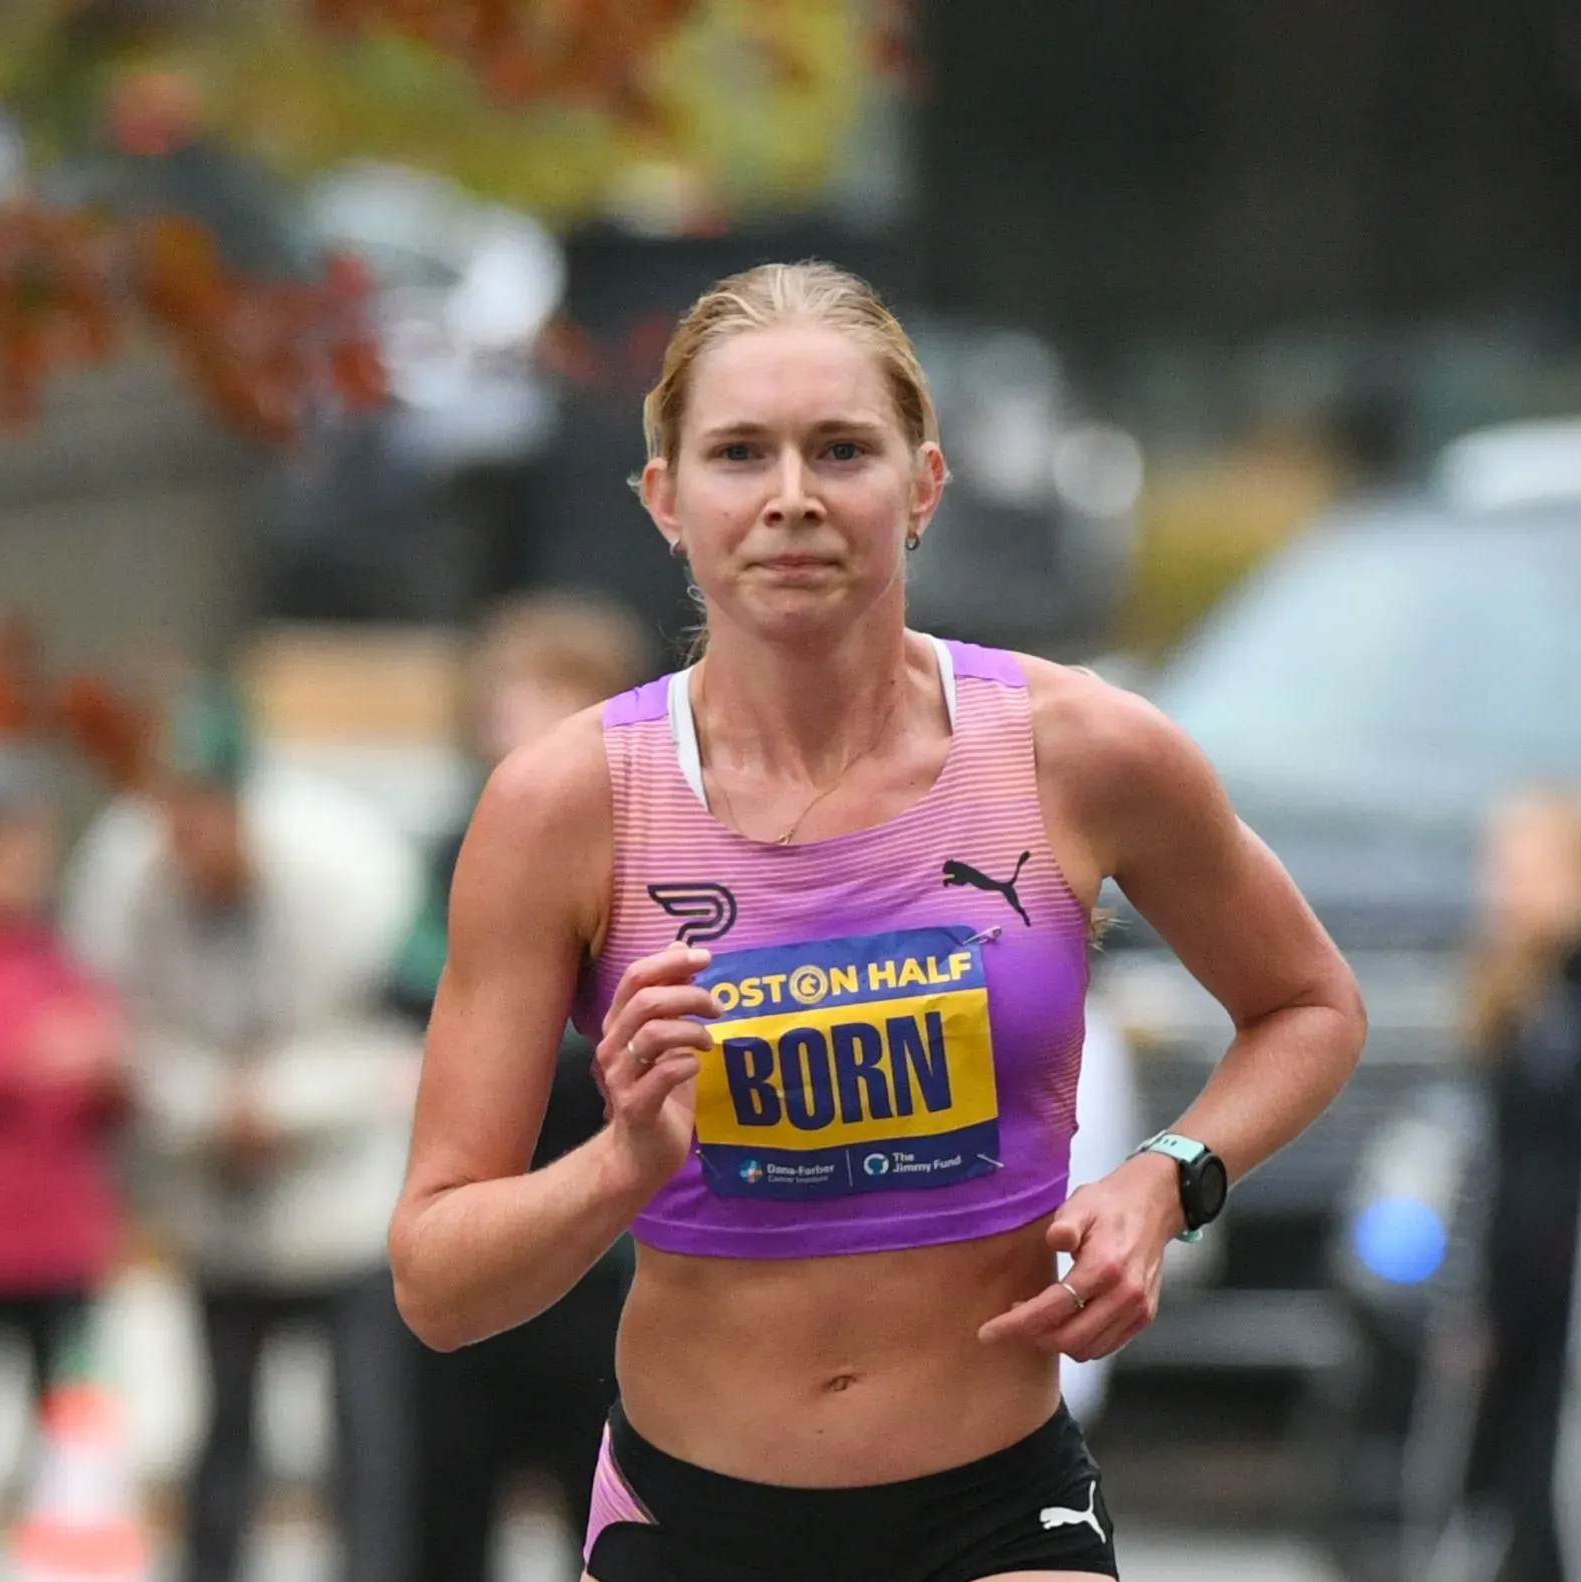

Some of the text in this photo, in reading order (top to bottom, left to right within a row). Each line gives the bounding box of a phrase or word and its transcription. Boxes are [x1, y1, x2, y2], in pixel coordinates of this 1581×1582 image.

[710, 952, 972, 1012] OSTON HALF
[723, 1011, 952, 1131] BORN
[892, 1152, 915, 1162] The
[892, 1154, 962, 1174] Jimmy Fund
